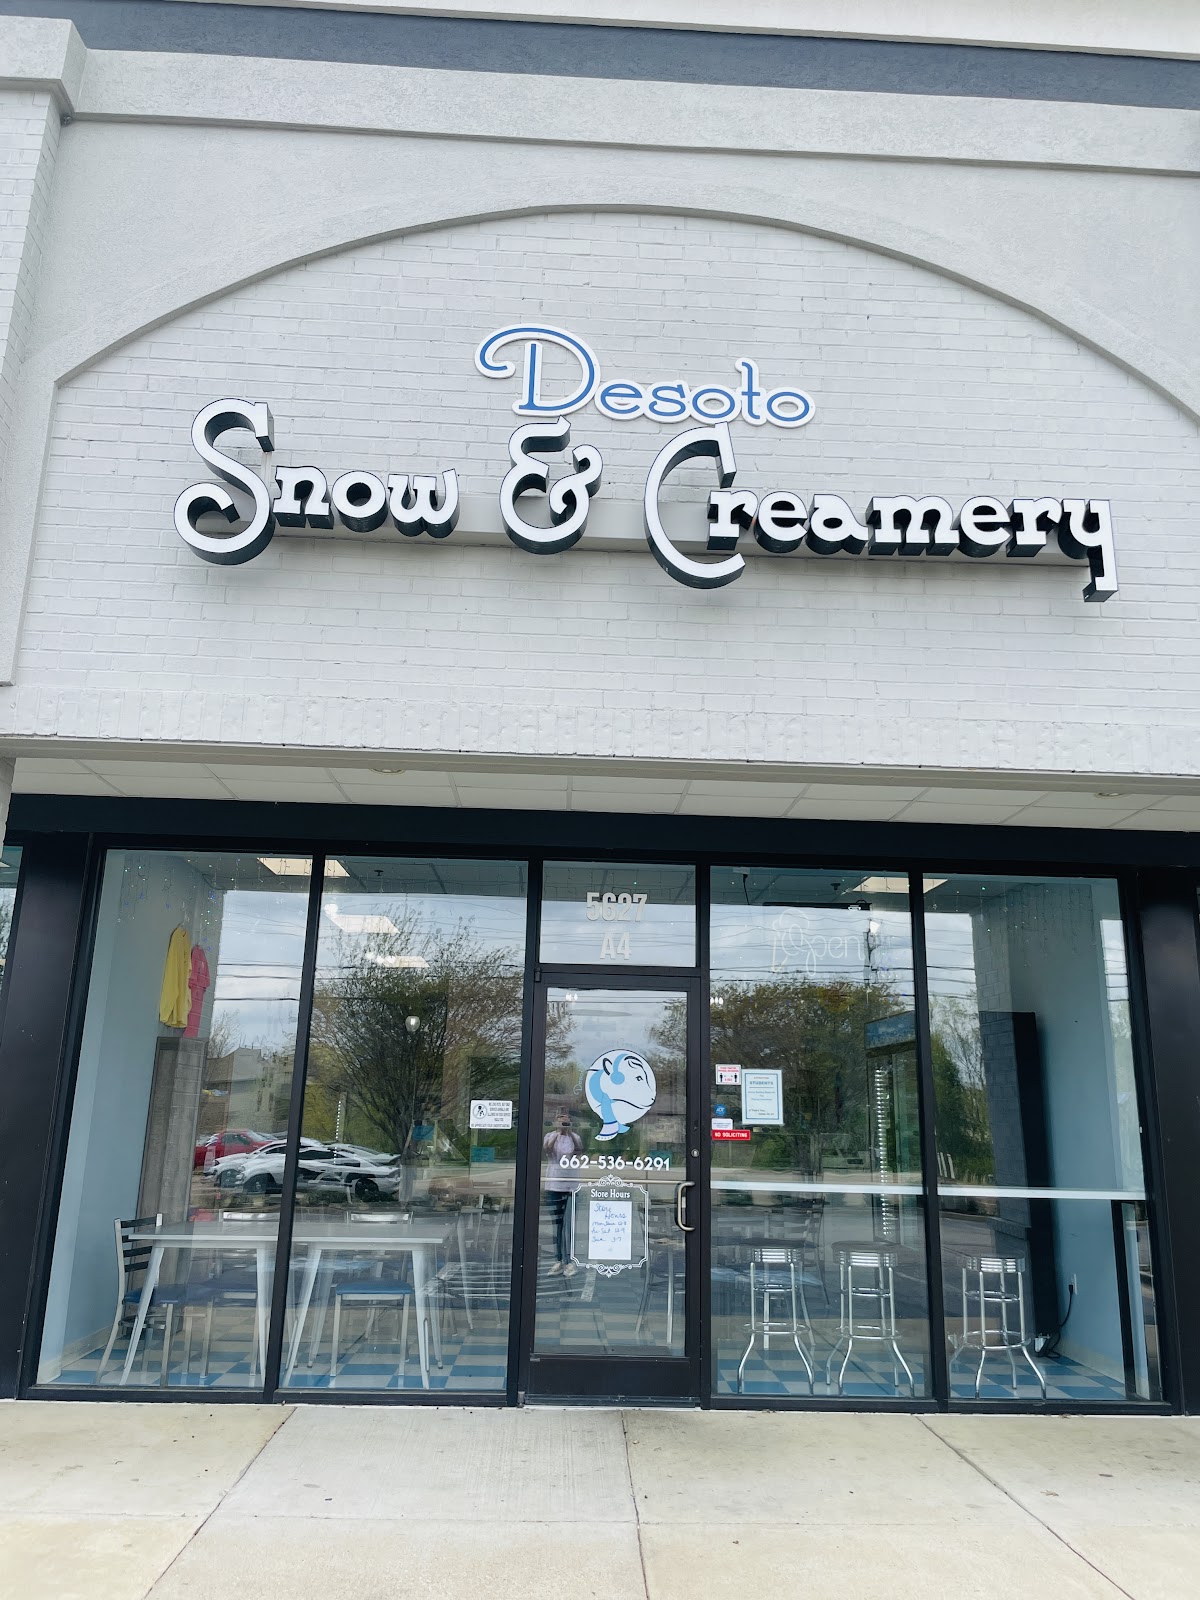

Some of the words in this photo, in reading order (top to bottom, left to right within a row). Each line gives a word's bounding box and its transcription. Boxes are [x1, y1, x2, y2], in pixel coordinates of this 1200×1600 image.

[475, 324, 816, 427] Desoto
[174, 398, 460, 563] Snow
[500, 416, 602, 552] &
[644, 422, 1119, 601] Creamery
[586, 891, 648, 922] 5627
[599, 930, 632, 960] A4
[781, 923, 866, 977] Open
[559, 1154, 670, 1171] 662-536-6291
[590, 1188, 609, 1198] Store
[610, 1188, 631, 1198] Hours
